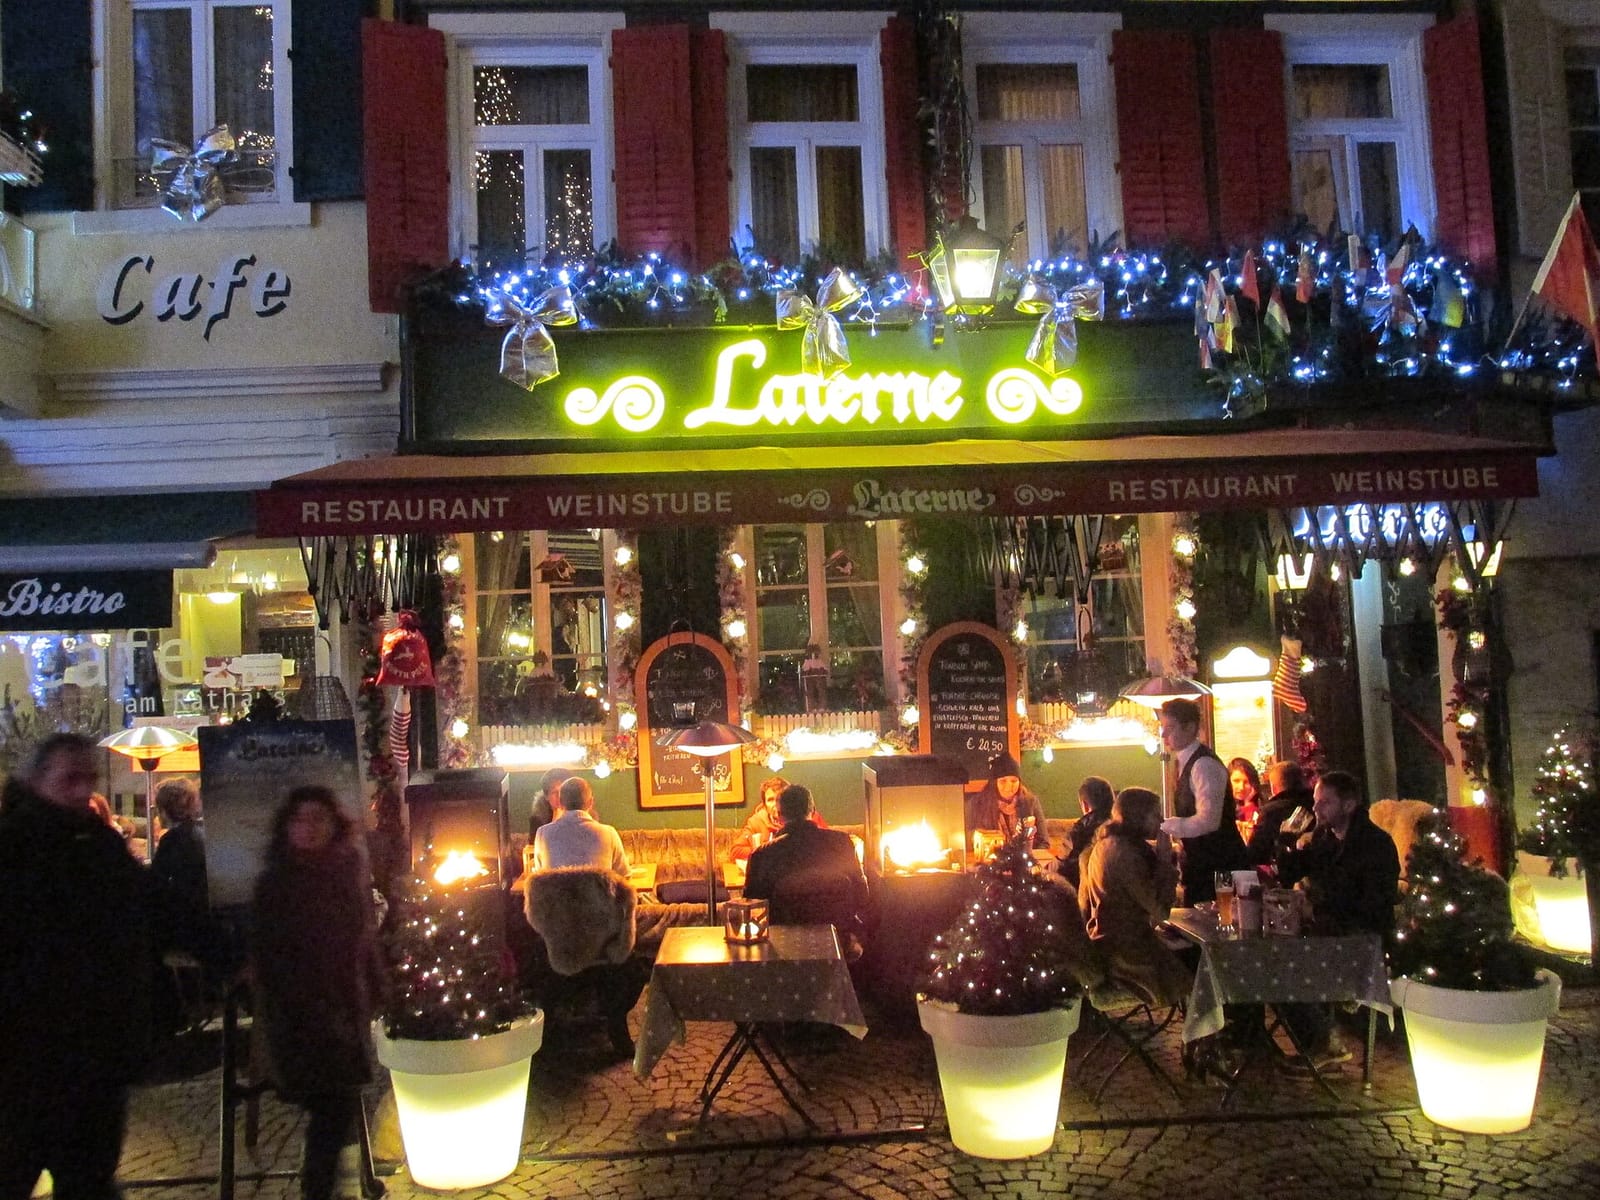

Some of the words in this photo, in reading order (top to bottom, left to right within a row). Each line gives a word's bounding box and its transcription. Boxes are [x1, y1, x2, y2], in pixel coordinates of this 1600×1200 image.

[98, 253, 291, 343] Cafe
[684, 338, 965, 428] Laterne
[301, 497, 509, 523] RESTAURANT
[547, 492, 732, 517] WEINSTUBE
[848, 479, 996, 518] Laterne
[1109, 474, 1297, 501] RESTAURANT
[1331, 467, 1498, 493] WEINSTUBE
[0, 577, 126, 617] Bistro
[126, 696, 155, 713] am
[174, 688, 286, 711] Rathas
[978, 737, 1004, 752] 20,50
